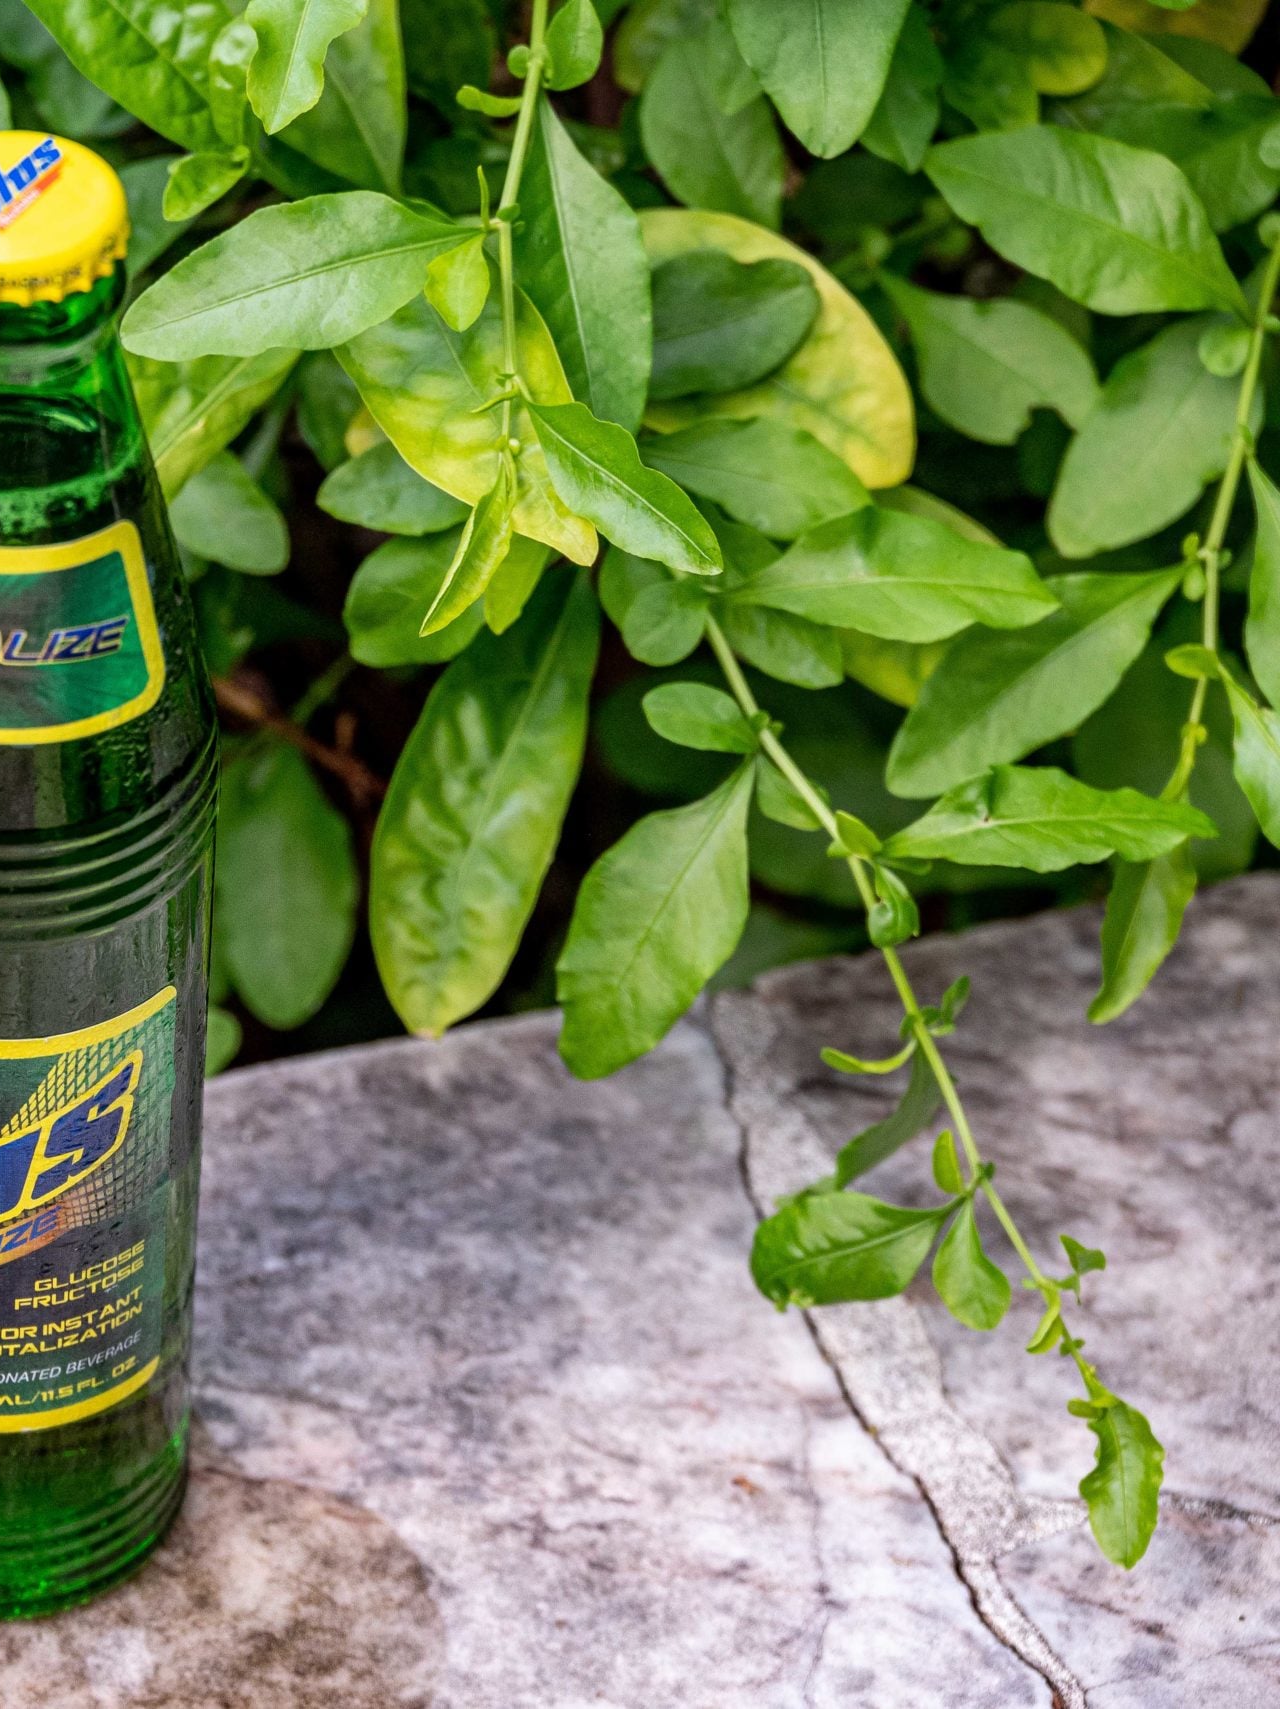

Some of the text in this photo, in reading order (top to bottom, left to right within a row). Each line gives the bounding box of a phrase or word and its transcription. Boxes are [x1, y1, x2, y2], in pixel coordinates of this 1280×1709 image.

[14, 1256, 145, 1311] FRUCTOSE
[34, 1239, 146, 1292] GLUCOSE
[42, 1284, 144, 1336] INSTANT
[65, 1328, 143, 1376] BEVERAGE
